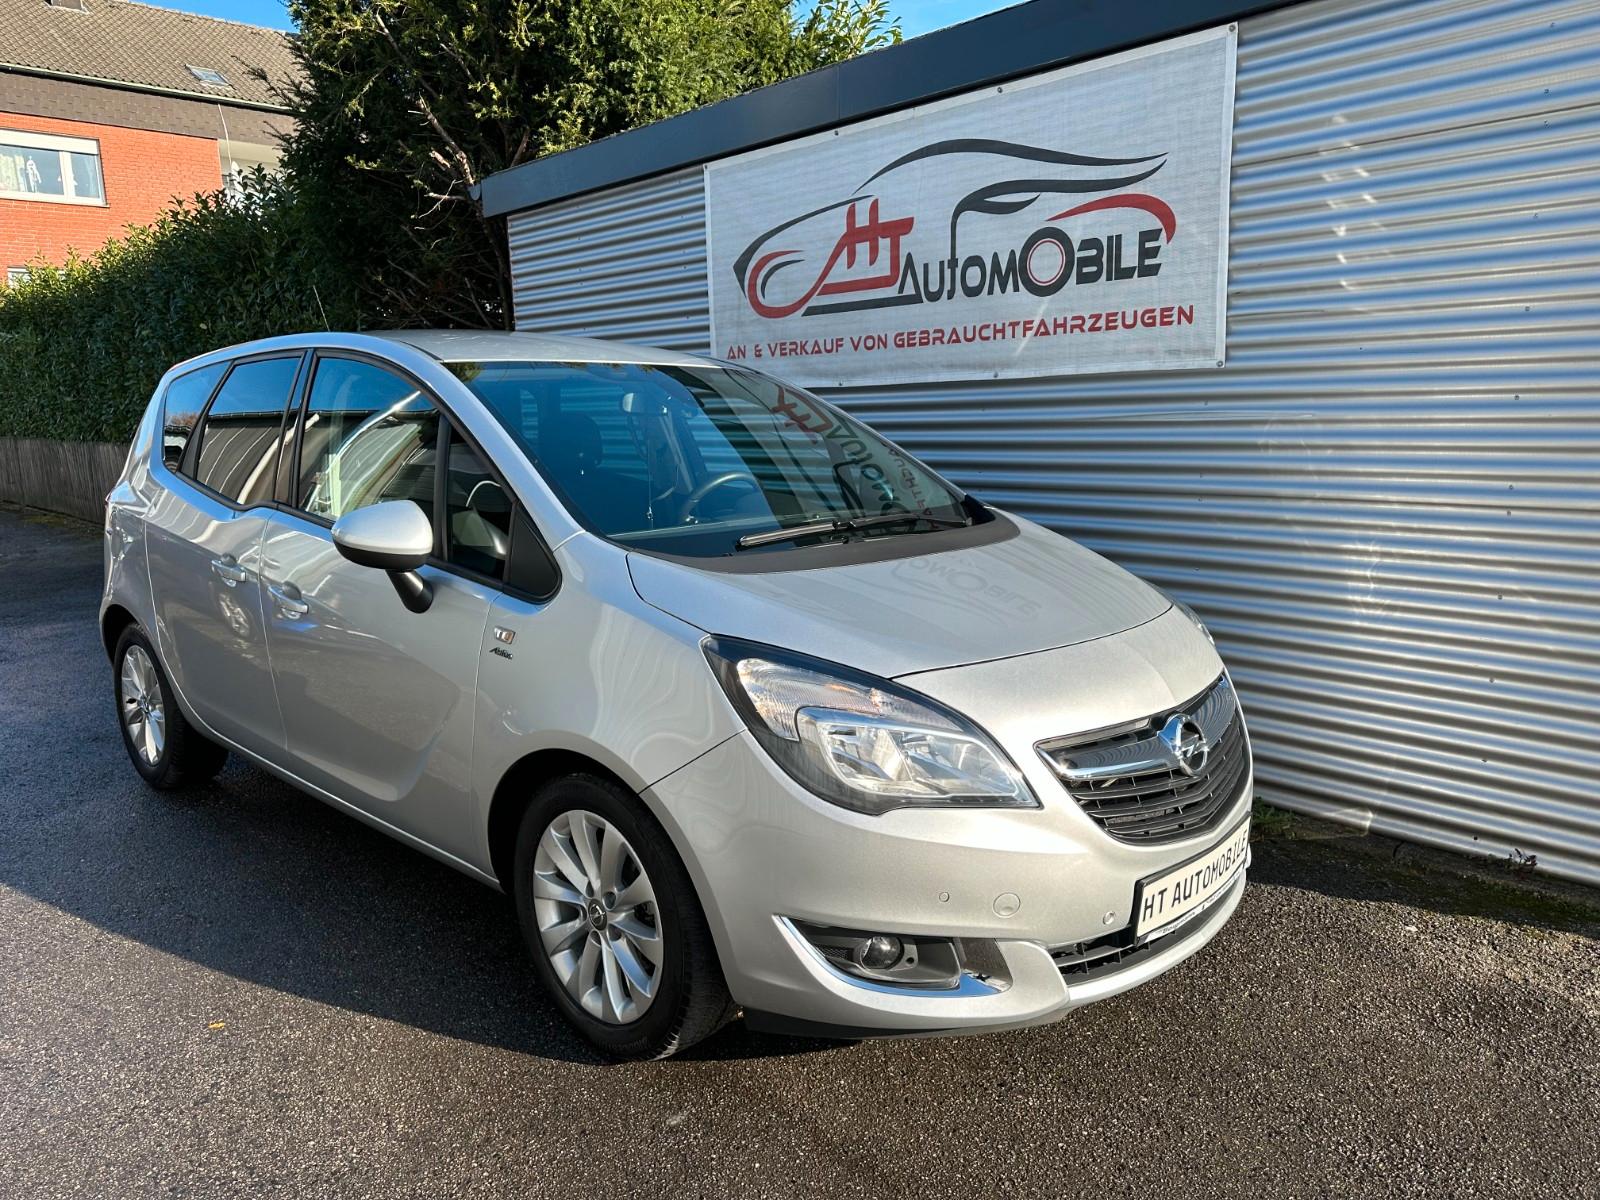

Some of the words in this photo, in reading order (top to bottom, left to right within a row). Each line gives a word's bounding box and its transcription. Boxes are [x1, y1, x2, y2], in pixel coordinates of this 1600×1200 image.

[727, 345, 747, 360] AN
[754, 343, 763, 358] &
[767, 337, 844, 358] VERKAUF
[850, 333, 888, 351] VON
[893, 304, 1195, 349] GEBRAUCHTFAHRZEUGEN
[1142, 887, 1168, 922] HT
[1171, 828, 1248, 908] AUTOMOBILE
